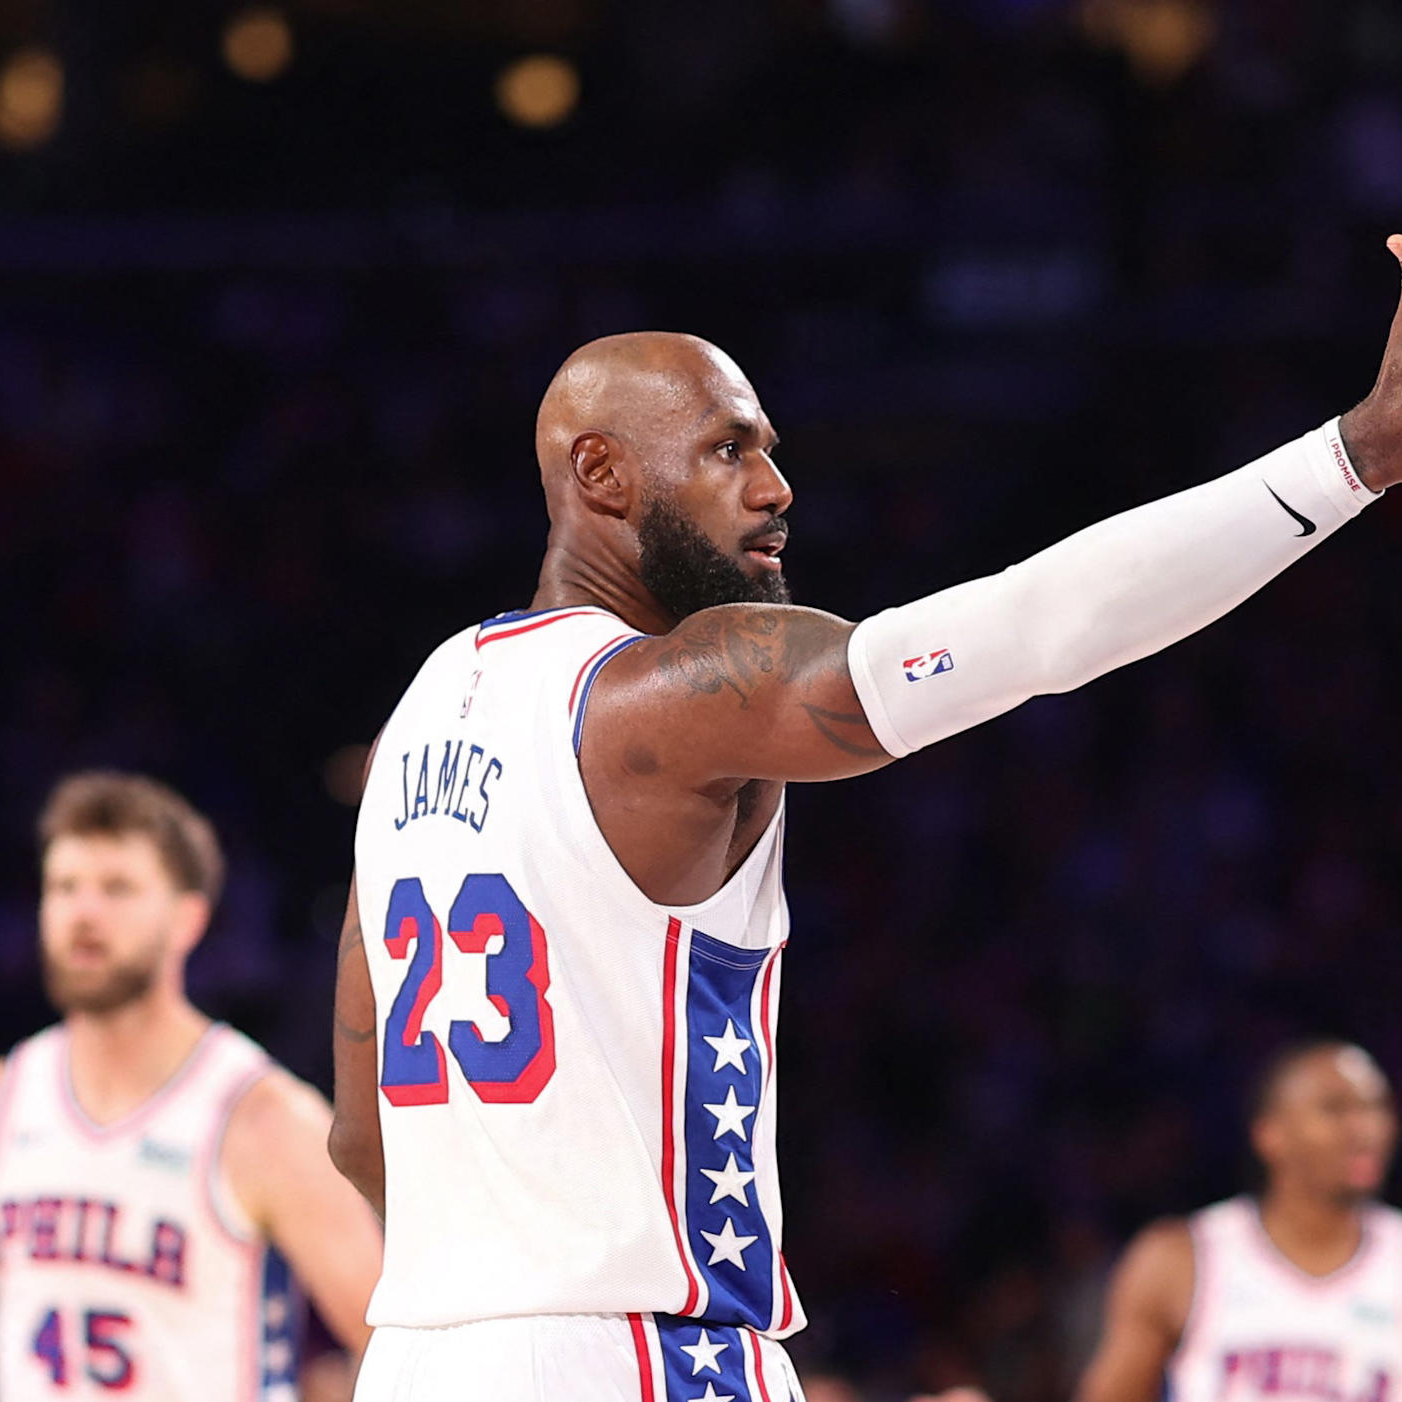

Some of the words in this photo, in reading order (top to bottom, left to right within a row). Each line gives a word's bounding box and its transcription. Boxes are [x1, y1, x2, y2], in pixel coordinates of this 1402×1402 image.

[1331, 442, 1361, 492] PROMISE
[394, 739, 503, 833] JAMES
[380, 873, 556, 1107] 23
[30, 1306, 136, 1394] 45
